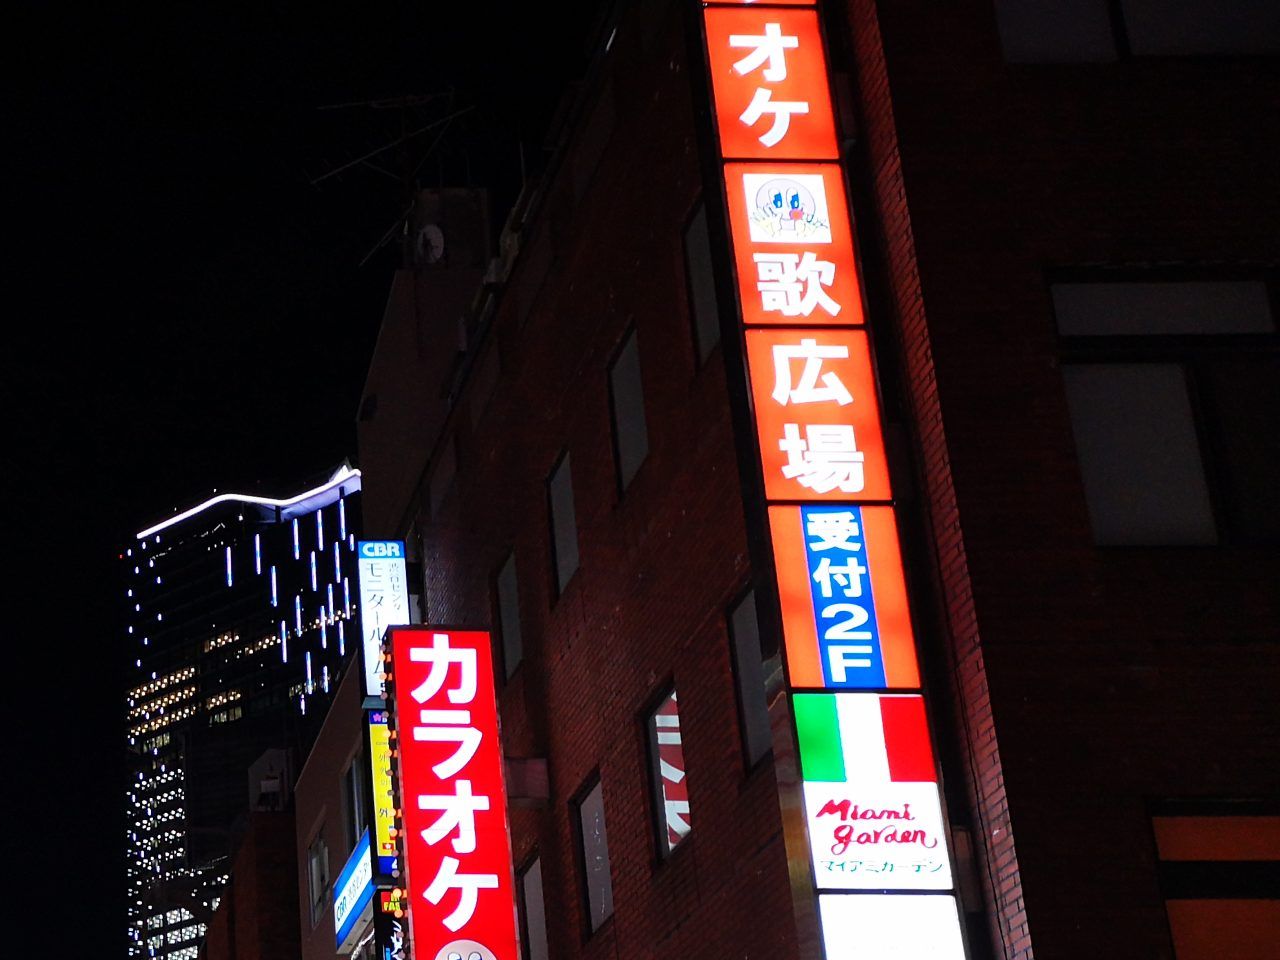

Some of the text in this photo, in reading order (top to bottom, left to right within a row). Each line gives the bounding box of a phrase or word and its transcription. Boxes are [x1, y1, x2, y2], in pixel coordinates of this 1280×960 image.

[362, 543, 401, 557] CBR
[806, 511, 873, 684] 受付2F
[816, 798, 916, 822] Miami
